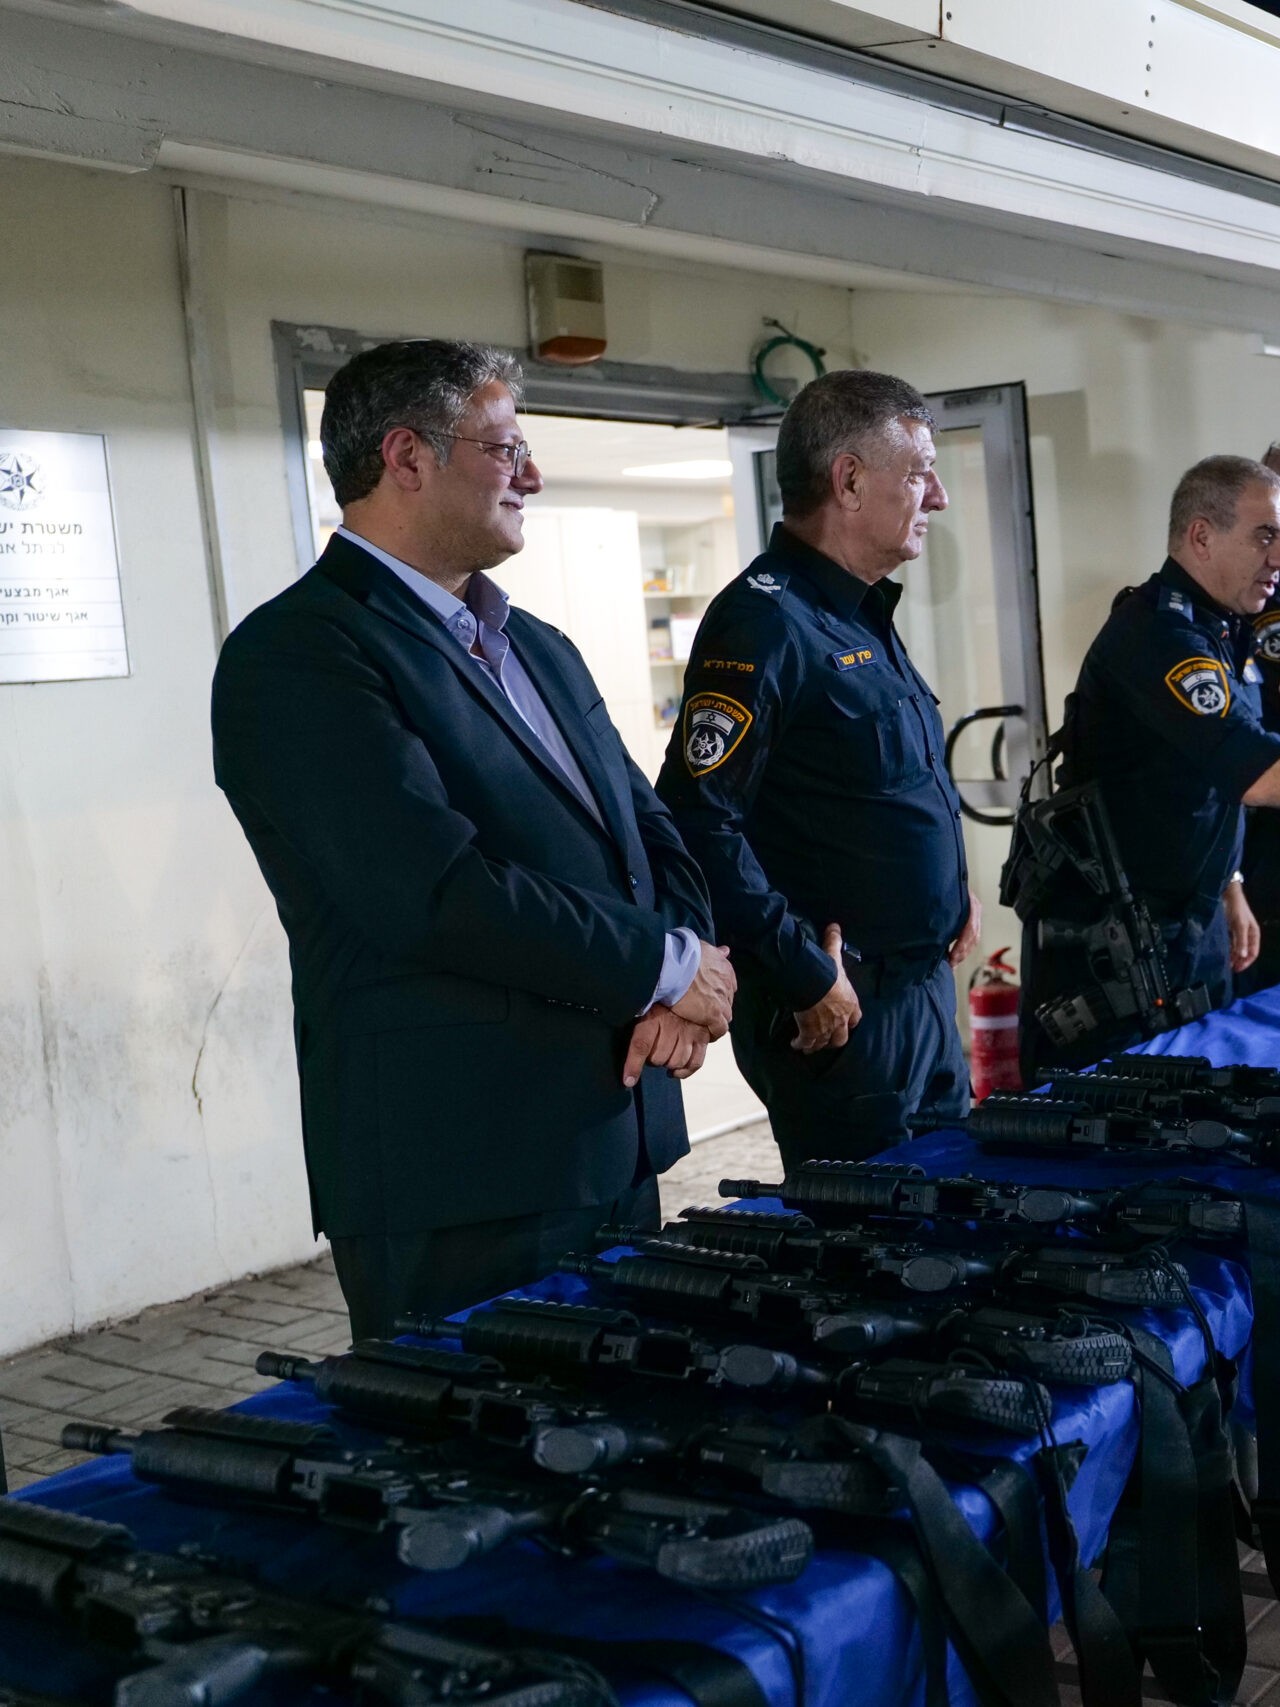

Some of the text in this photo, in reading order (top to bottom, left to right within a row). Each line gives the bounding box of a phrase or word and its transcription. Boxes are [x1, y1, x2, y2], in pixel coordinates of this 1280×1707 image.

[21, 522, 83, 535] משטרת
[21, 540, 43, 554] תל
[46, 587, 70, 599] אגף
[23, 612, 60, 623] שיטור
[65, 611, 88, 624] אגף
